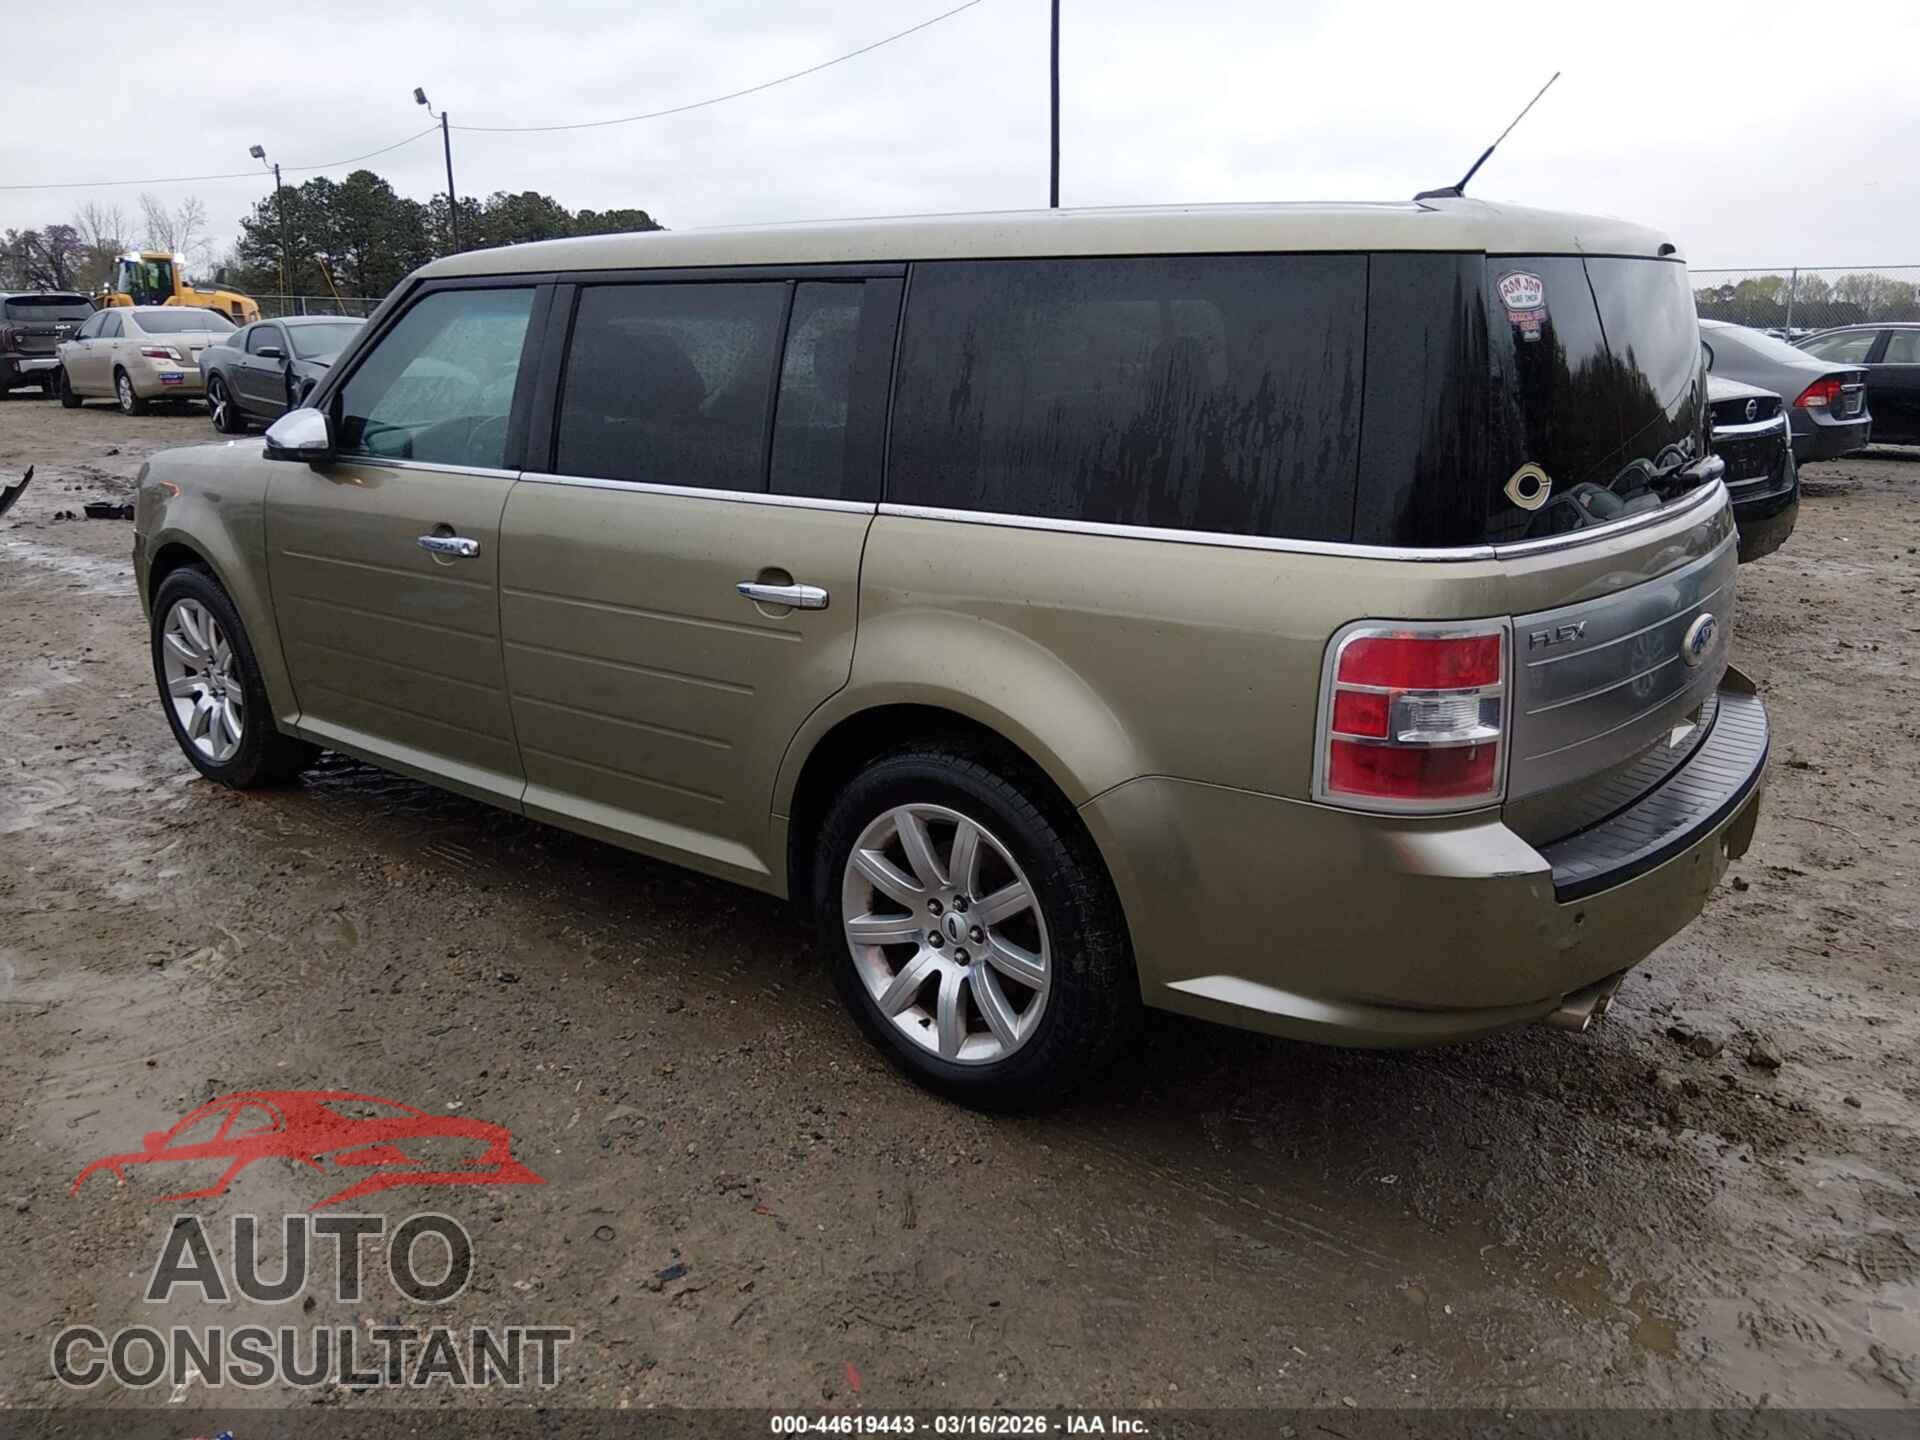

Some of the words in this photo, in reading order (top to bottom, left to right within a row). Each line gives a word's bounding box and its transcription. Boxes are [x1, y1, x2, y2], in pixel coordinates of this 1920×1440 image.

[1503, 277, 1521, 296] RON
[1523, 278, 1540, 293] JON
[1529, 620, 1587, 650] FLEX
